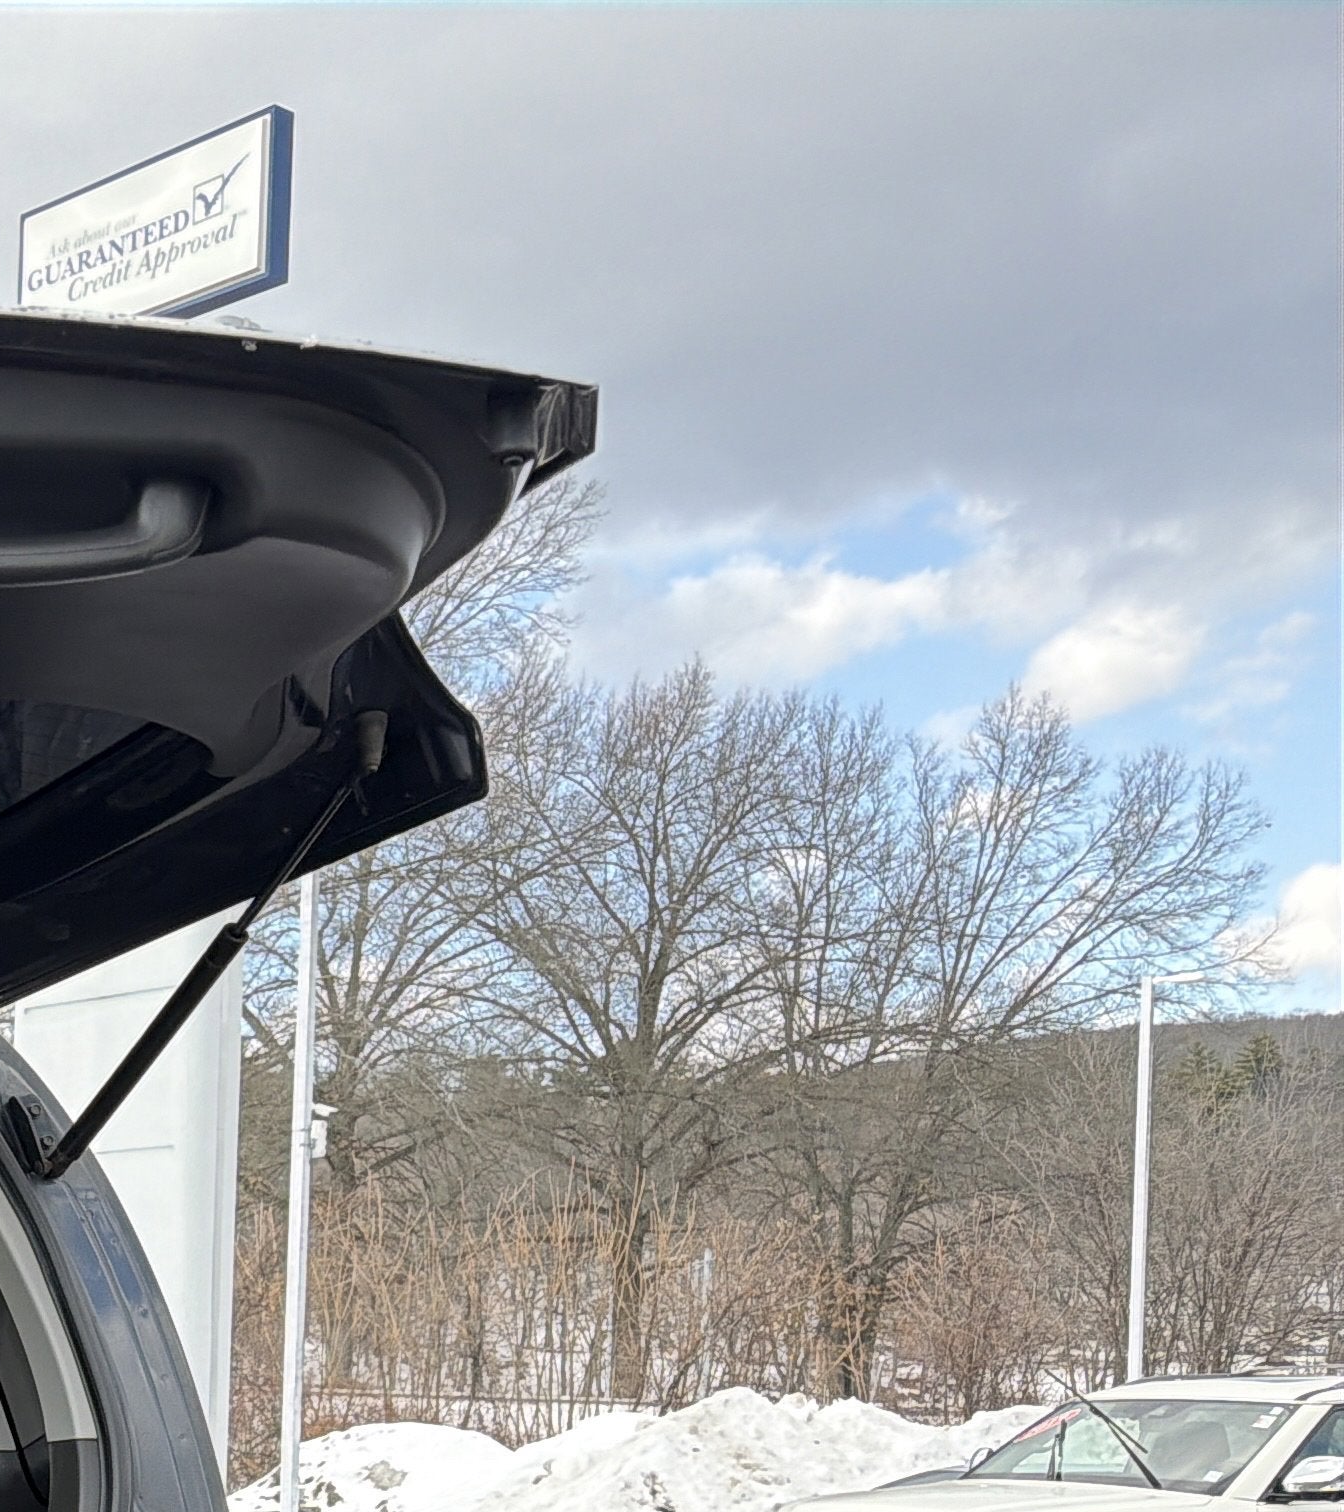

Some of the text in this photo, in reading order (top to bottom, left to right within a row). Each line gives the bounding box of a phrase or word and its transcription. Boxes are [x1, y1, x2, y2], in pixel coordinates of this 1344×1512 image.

[27, 209, 190, 292] GUARANTEED
[68, 213, 238, 302] Credit Approval
[74, 222, 111, 249] about
[114, 213, 137, 232] our
